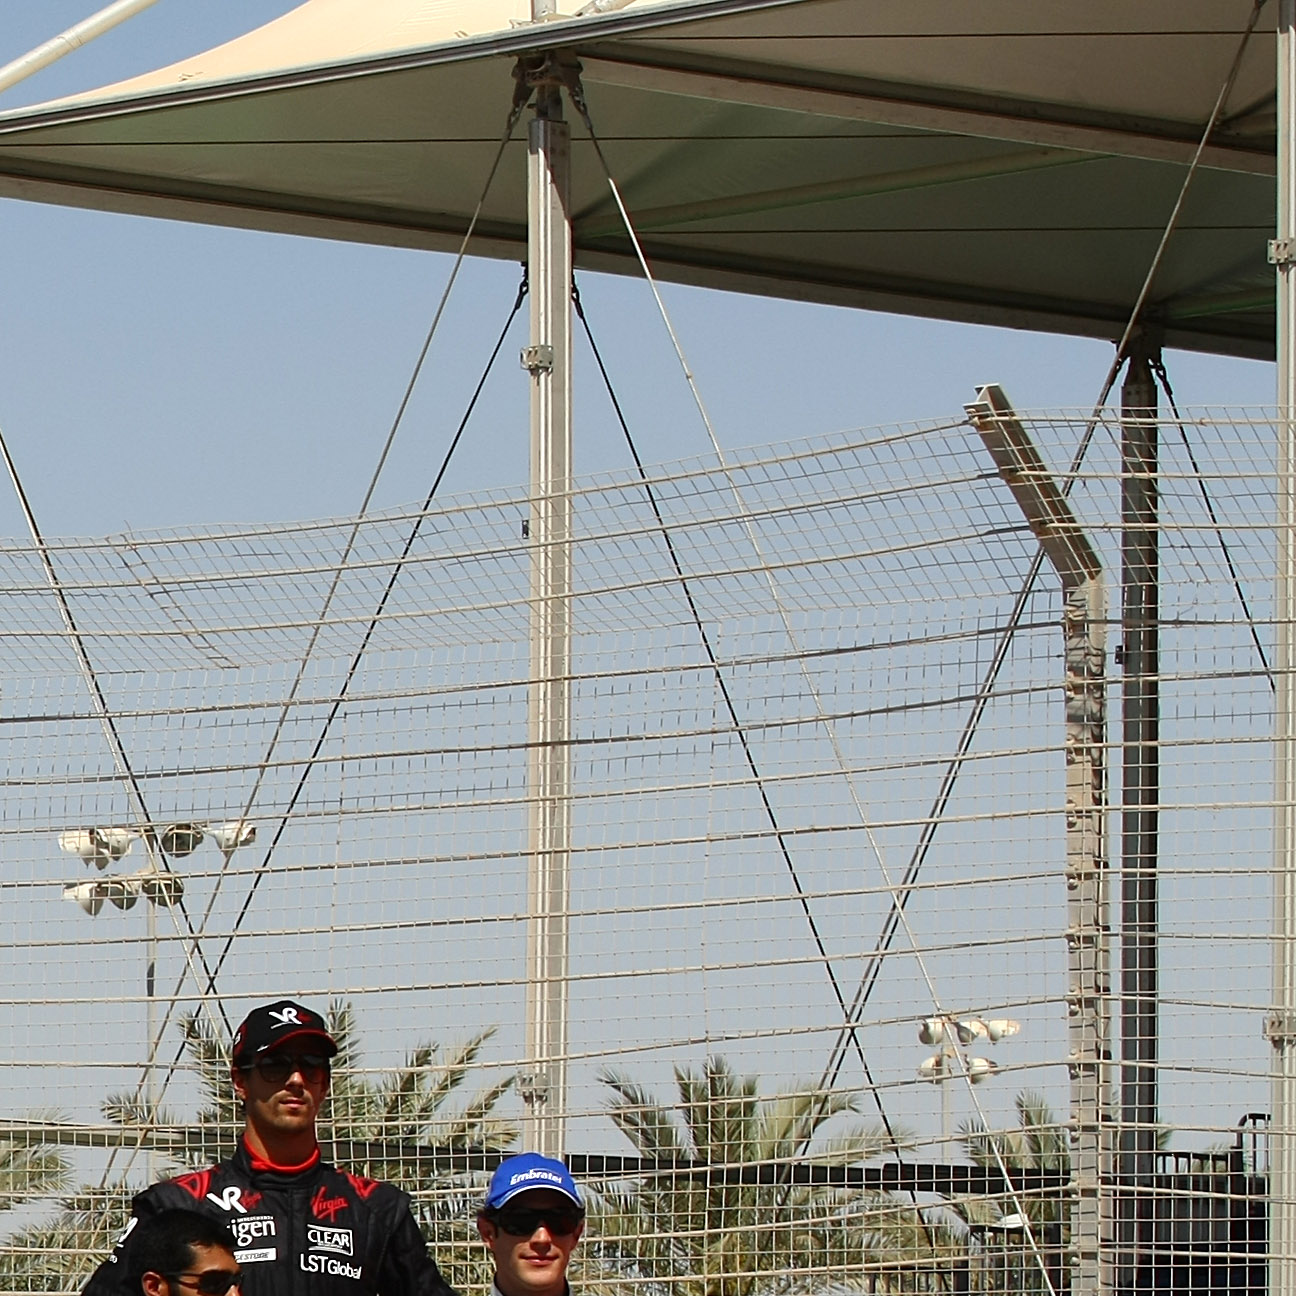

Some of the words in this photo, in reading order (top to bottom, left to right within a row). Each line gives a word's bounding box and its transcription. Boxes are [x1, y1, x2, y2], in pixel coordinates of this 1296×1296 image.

[510, 1168, 563, 1186] Embratel
[227, 1218, 275, 1246] igen
[308, 1229, 349, 1247] CLEAR
[328, 1259, 362, 1279] Global
